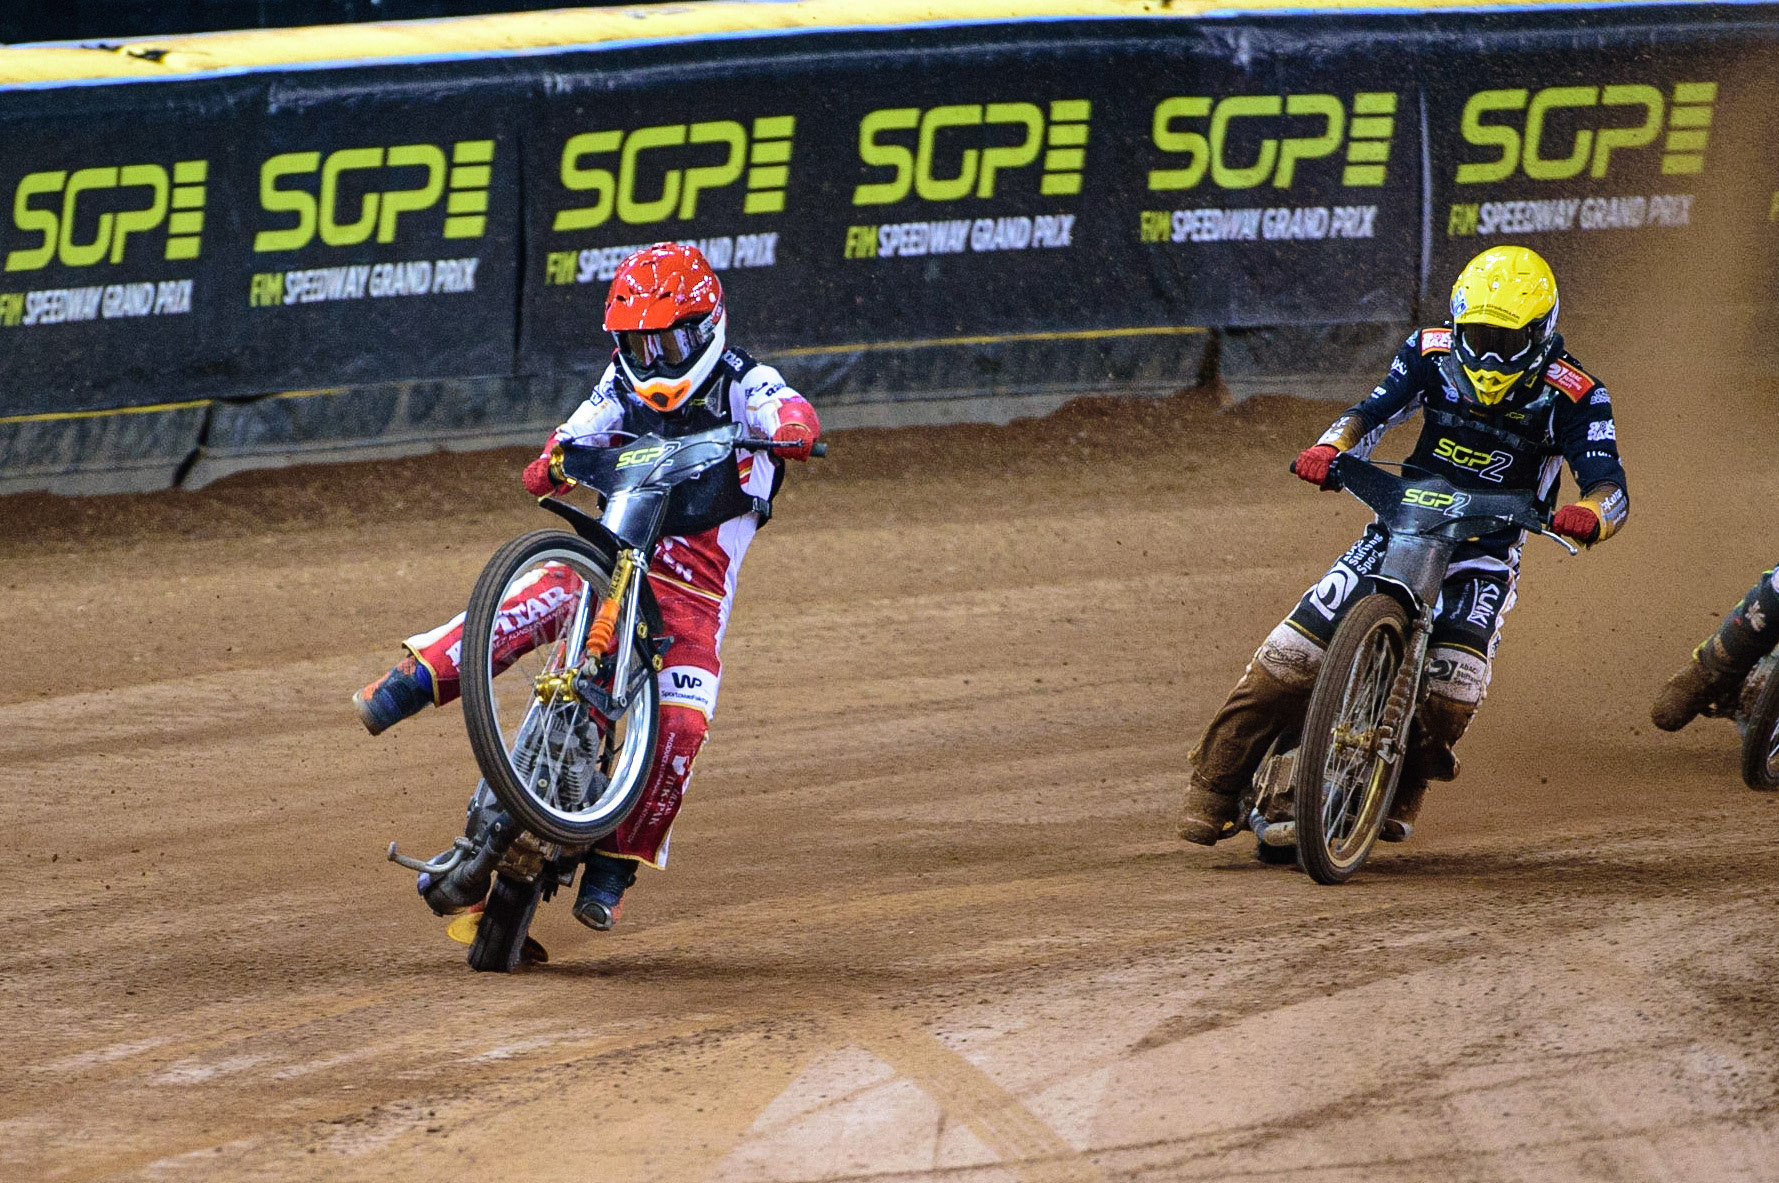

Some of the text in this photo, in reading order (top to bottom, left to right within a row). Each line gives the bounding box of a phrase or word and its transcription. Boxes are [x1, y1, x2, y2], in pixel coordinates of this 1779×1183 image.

[852, 102, 1045, 206] SGP
[1148, 94, 1345, 190] SGP
[1455, 84, 1665, 184] SGP
[253, 144, 446, 252] SGP
[552, 120, 747, 231] SGP
[4, 164, 168, 271] SGP
[844, 214, 1076, 259] FIM SPEEDWAY GRAND PRIX
[1140, 205, 1378, 243] FIM SPEEDWAY GRAND PRIX
[1448, 194, 1695, 236] FIM SPEEDWAY GRAND PRIX
[733, 232, 779, 268] PRIX
[23, 286, 103, 325] SPEEDWAY
[102, 282, 156, 319] GRAND
[153, 279, 194, 315] PRIX
[250, 257, 479, 307] FIM SPEEDWAY GRAND PRIX
[672, 672, 702, 689] WP
